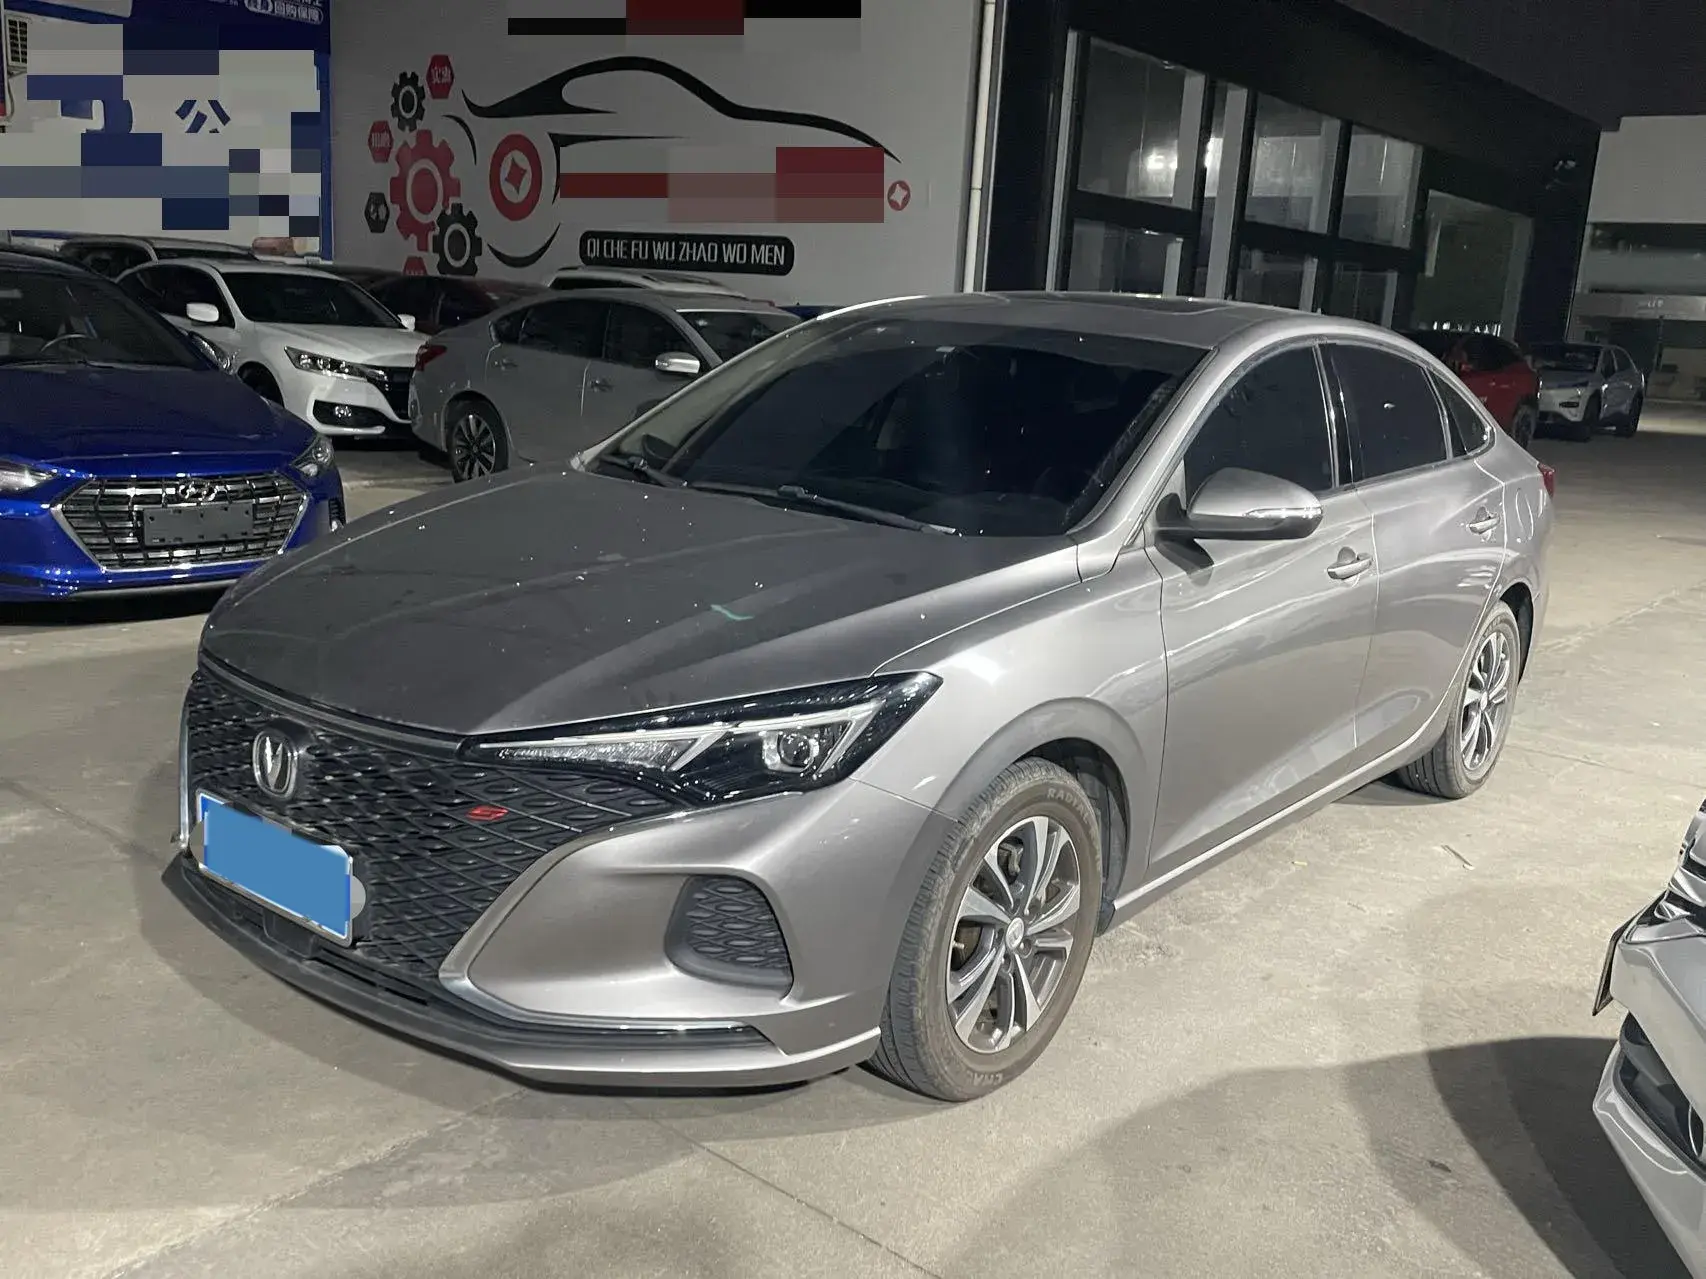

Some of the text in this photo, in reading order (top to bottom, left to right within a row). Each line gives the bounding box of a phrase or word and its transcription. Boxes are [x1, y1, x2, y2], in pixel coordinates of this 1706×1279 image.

[586, 238, 786, 267] QI CHE FU WU ZHAO WO MEN
